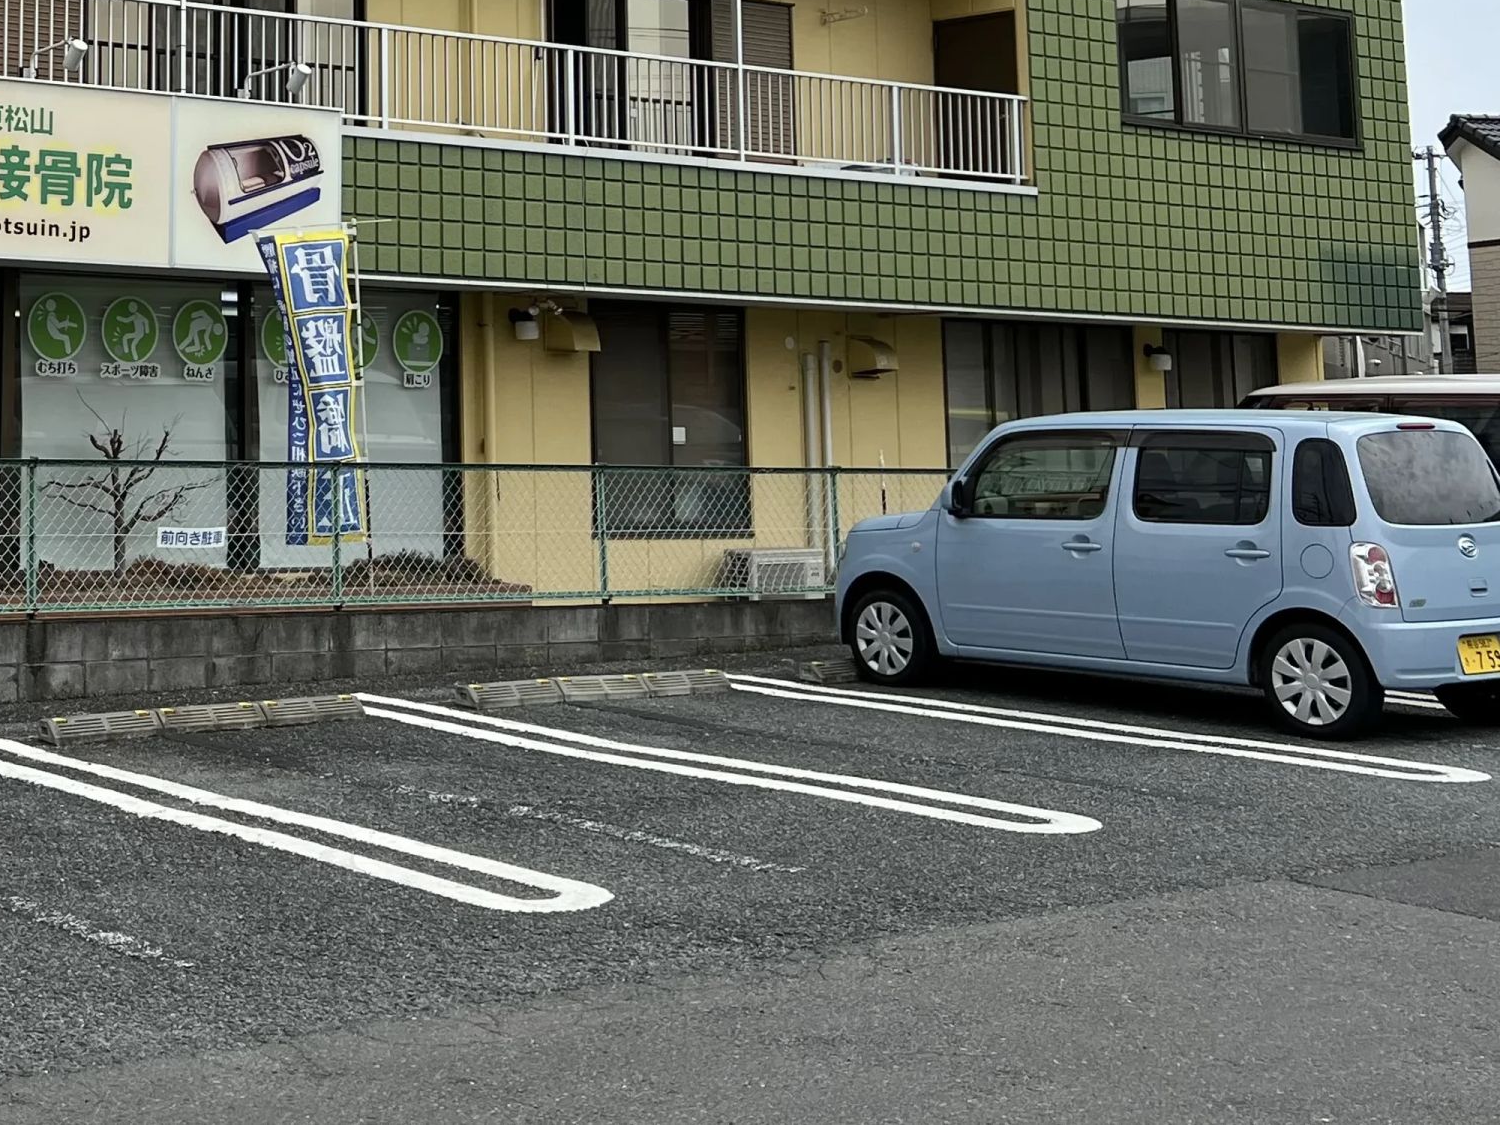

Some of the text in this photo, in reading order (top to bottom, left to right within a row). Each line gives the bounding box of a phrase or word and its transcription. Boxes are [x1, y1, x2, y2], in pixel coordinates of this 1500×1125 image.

[290, 156, 320, 175] capsule
[35, 361, 77, 376] むち打ち
[100, 363, 160, 379] スポーツ障害
[185, 365, 215, 381] ねんざ
[404, 372, 431, 387] 肩こり
[160, 530, 223, 547] 前向き駐車
